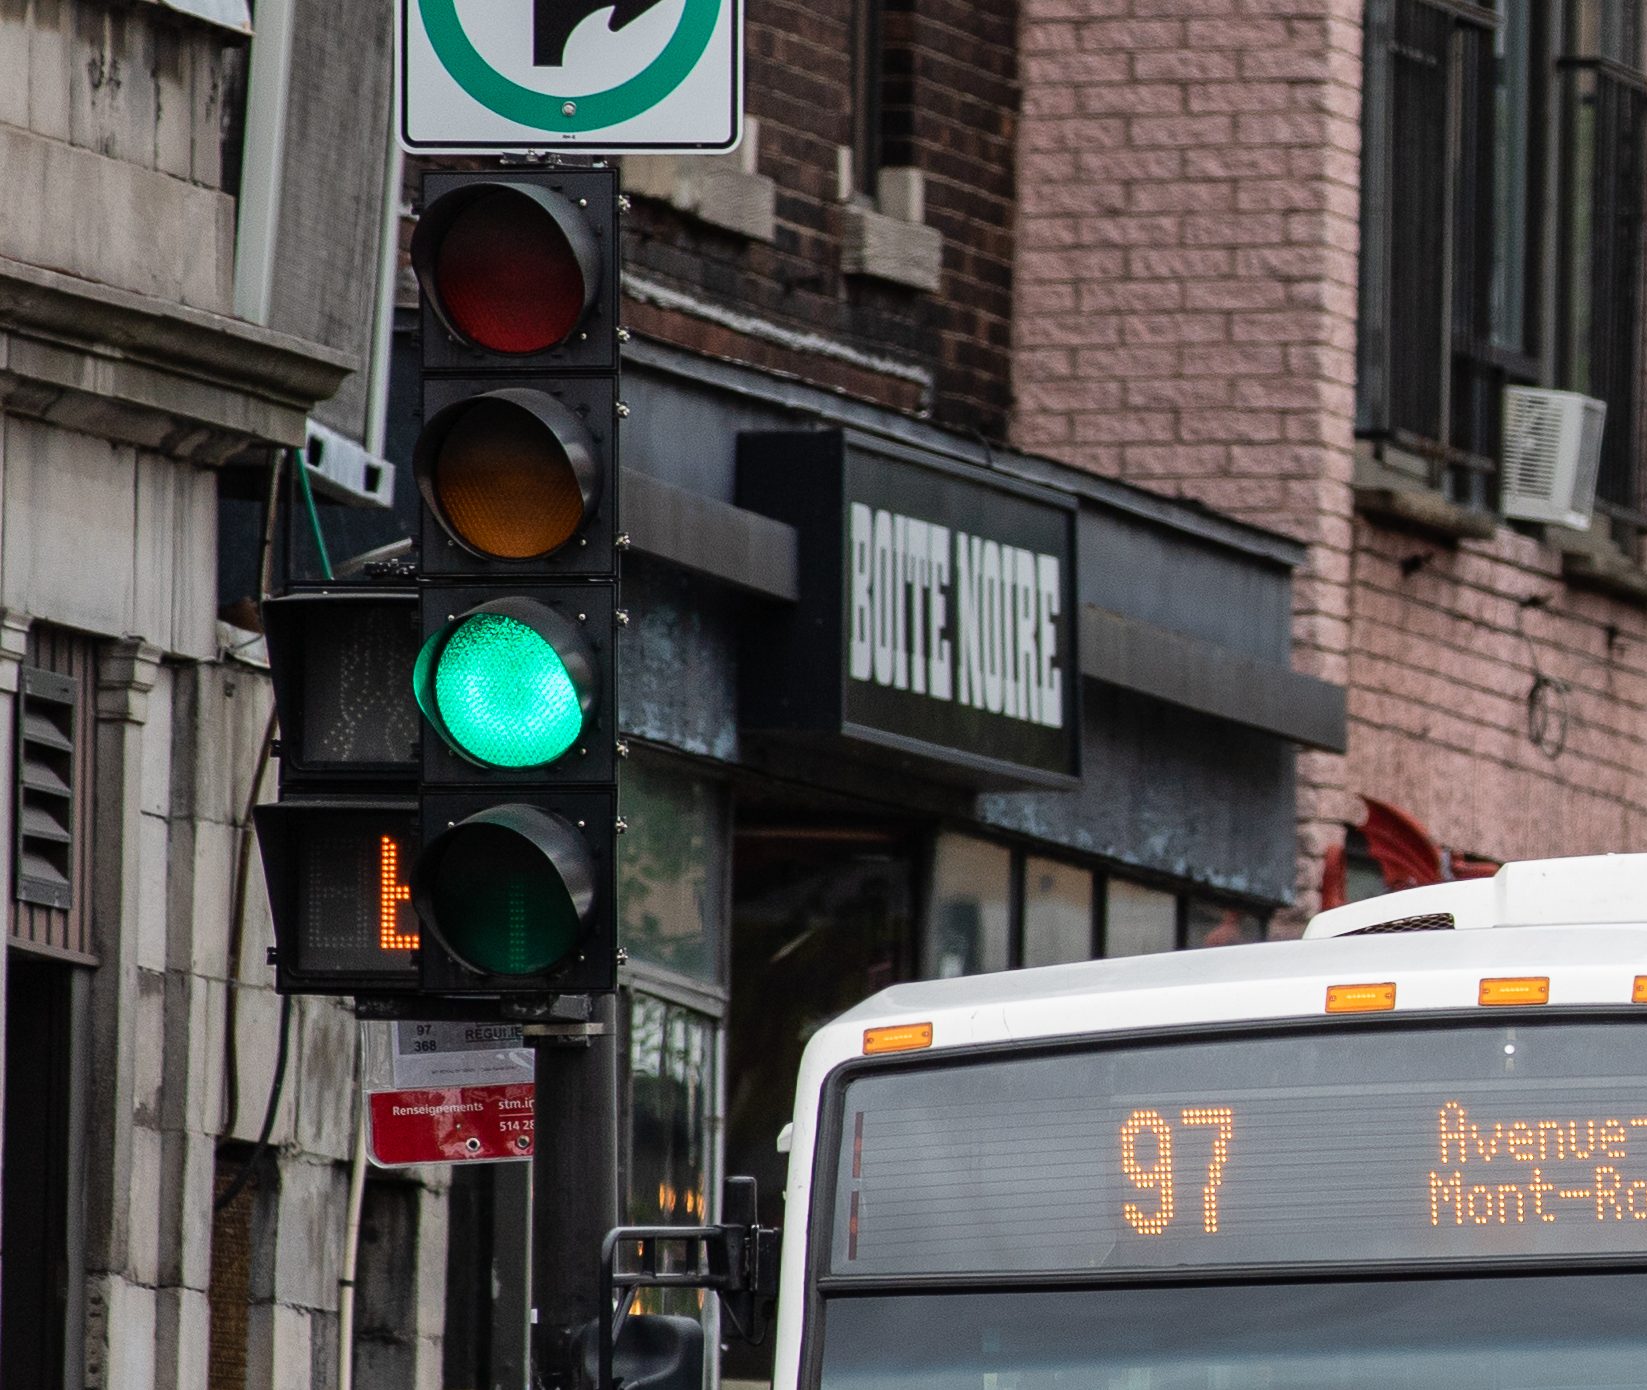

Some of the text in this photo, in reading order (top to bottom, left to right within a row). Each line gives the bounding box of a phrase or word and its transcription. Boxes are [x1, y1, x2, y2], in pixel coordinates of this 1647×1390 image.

[850, 500, 1063, 729] BOITE NOIRE
[416, 1024, 432, 1036] 97
[414, 1040, 437, 1052] 368
[392, 1102, 484, 1117] Renseignements
[499, 1120, 520, 1132] 514
[1120, 1107, 1233, 1236] 97
